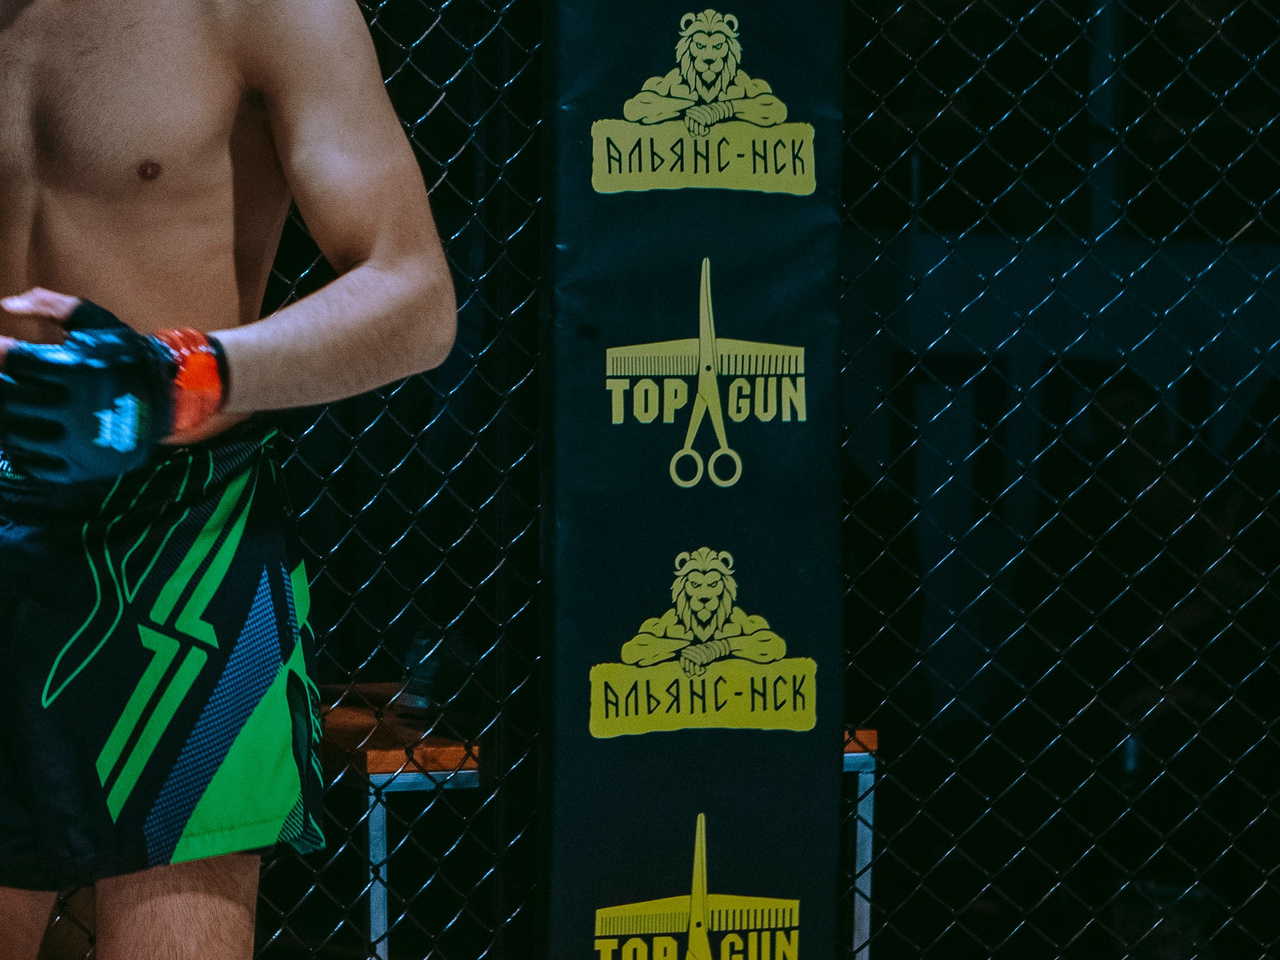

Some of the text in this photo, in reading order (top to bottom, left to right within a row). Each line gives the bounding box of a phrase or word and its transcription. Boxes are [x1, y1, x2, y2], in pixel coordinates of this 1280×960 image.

[606, 137, 804, 175] АЛЬЯНС-НСК
[606, 376, 807, 425] TOP GUN
[604, 674, 805, 719] АЛЬЯНС-НСК
